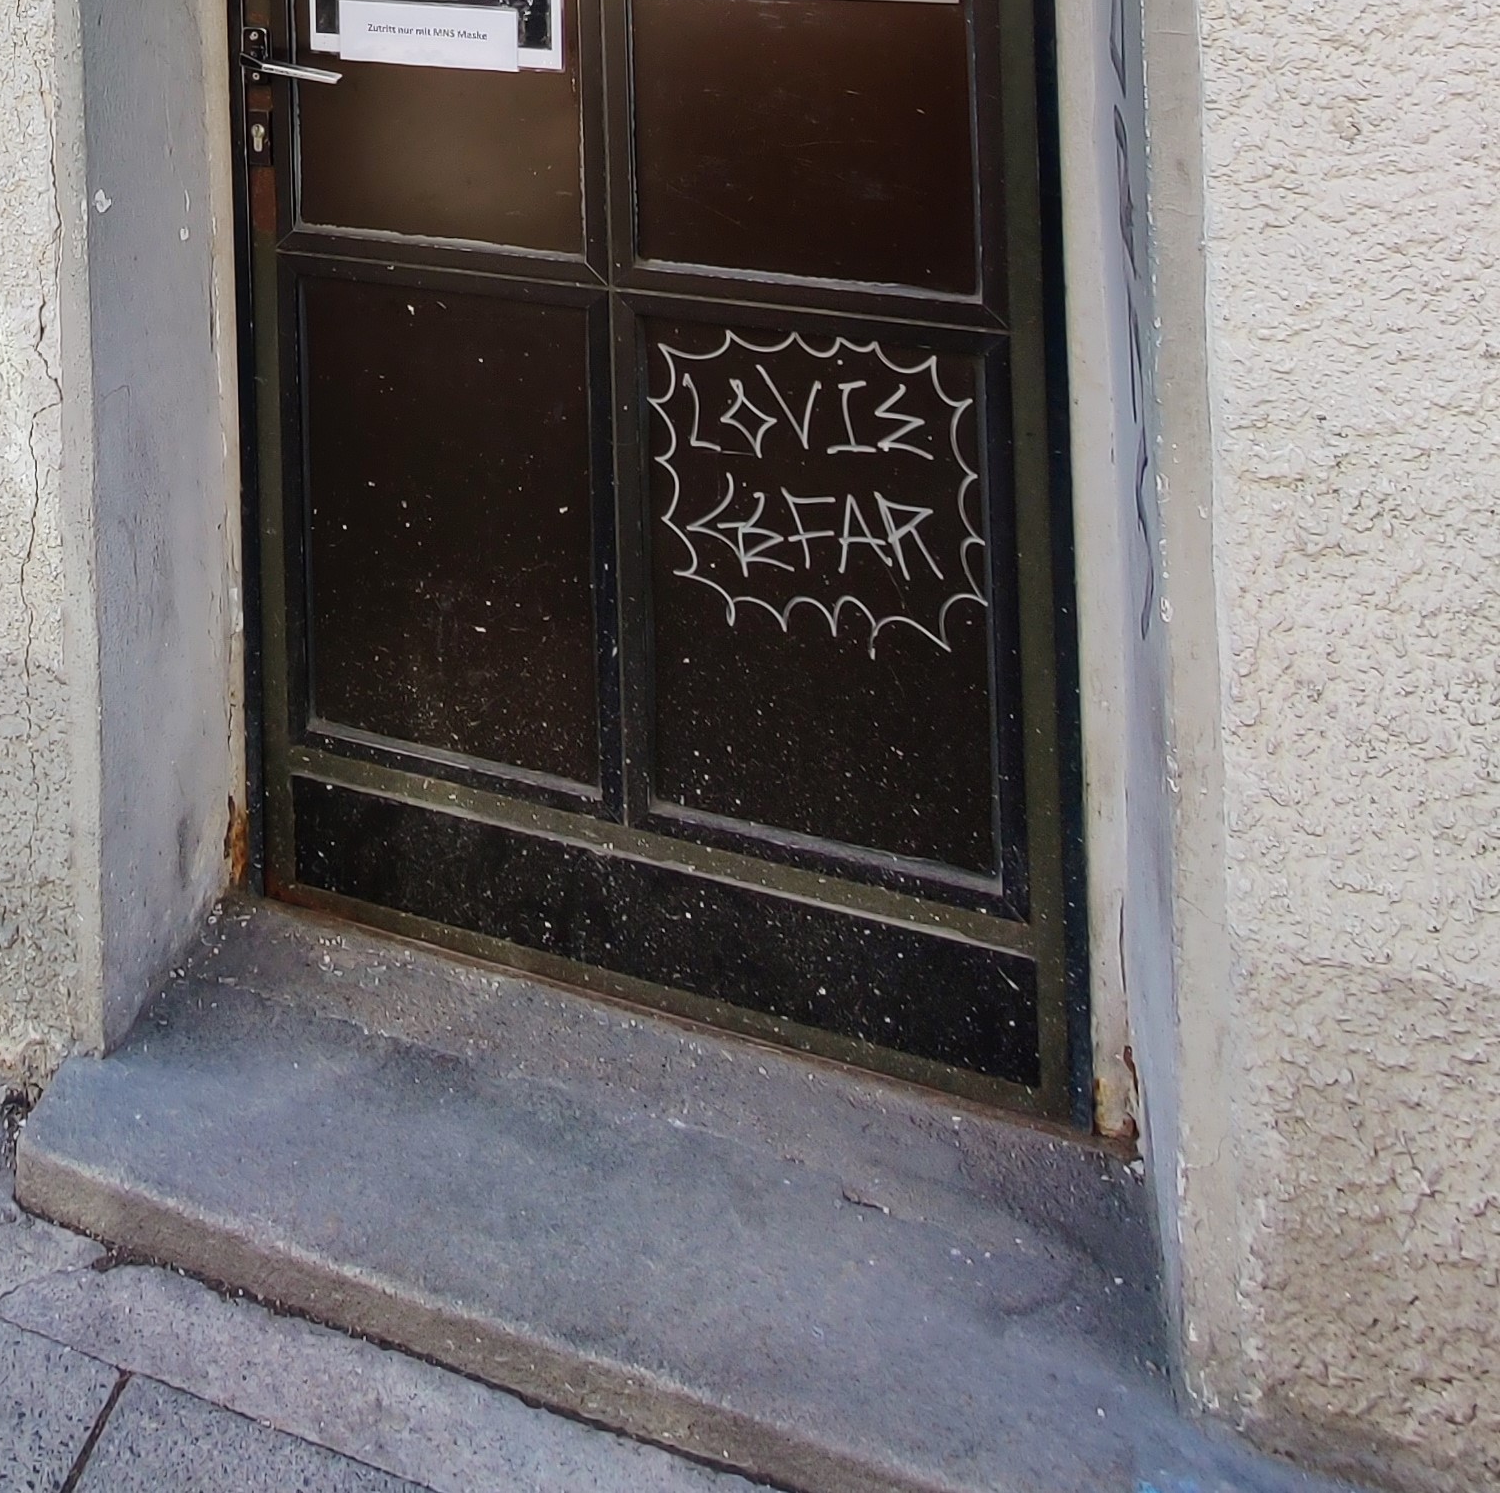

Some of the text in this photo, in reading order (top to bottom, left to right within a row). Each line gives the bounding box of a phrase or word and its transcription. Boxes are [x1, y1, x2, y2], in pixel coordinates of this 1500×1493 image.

[367, 23, 488, 41] Zutritt nur mit MNS Maske
